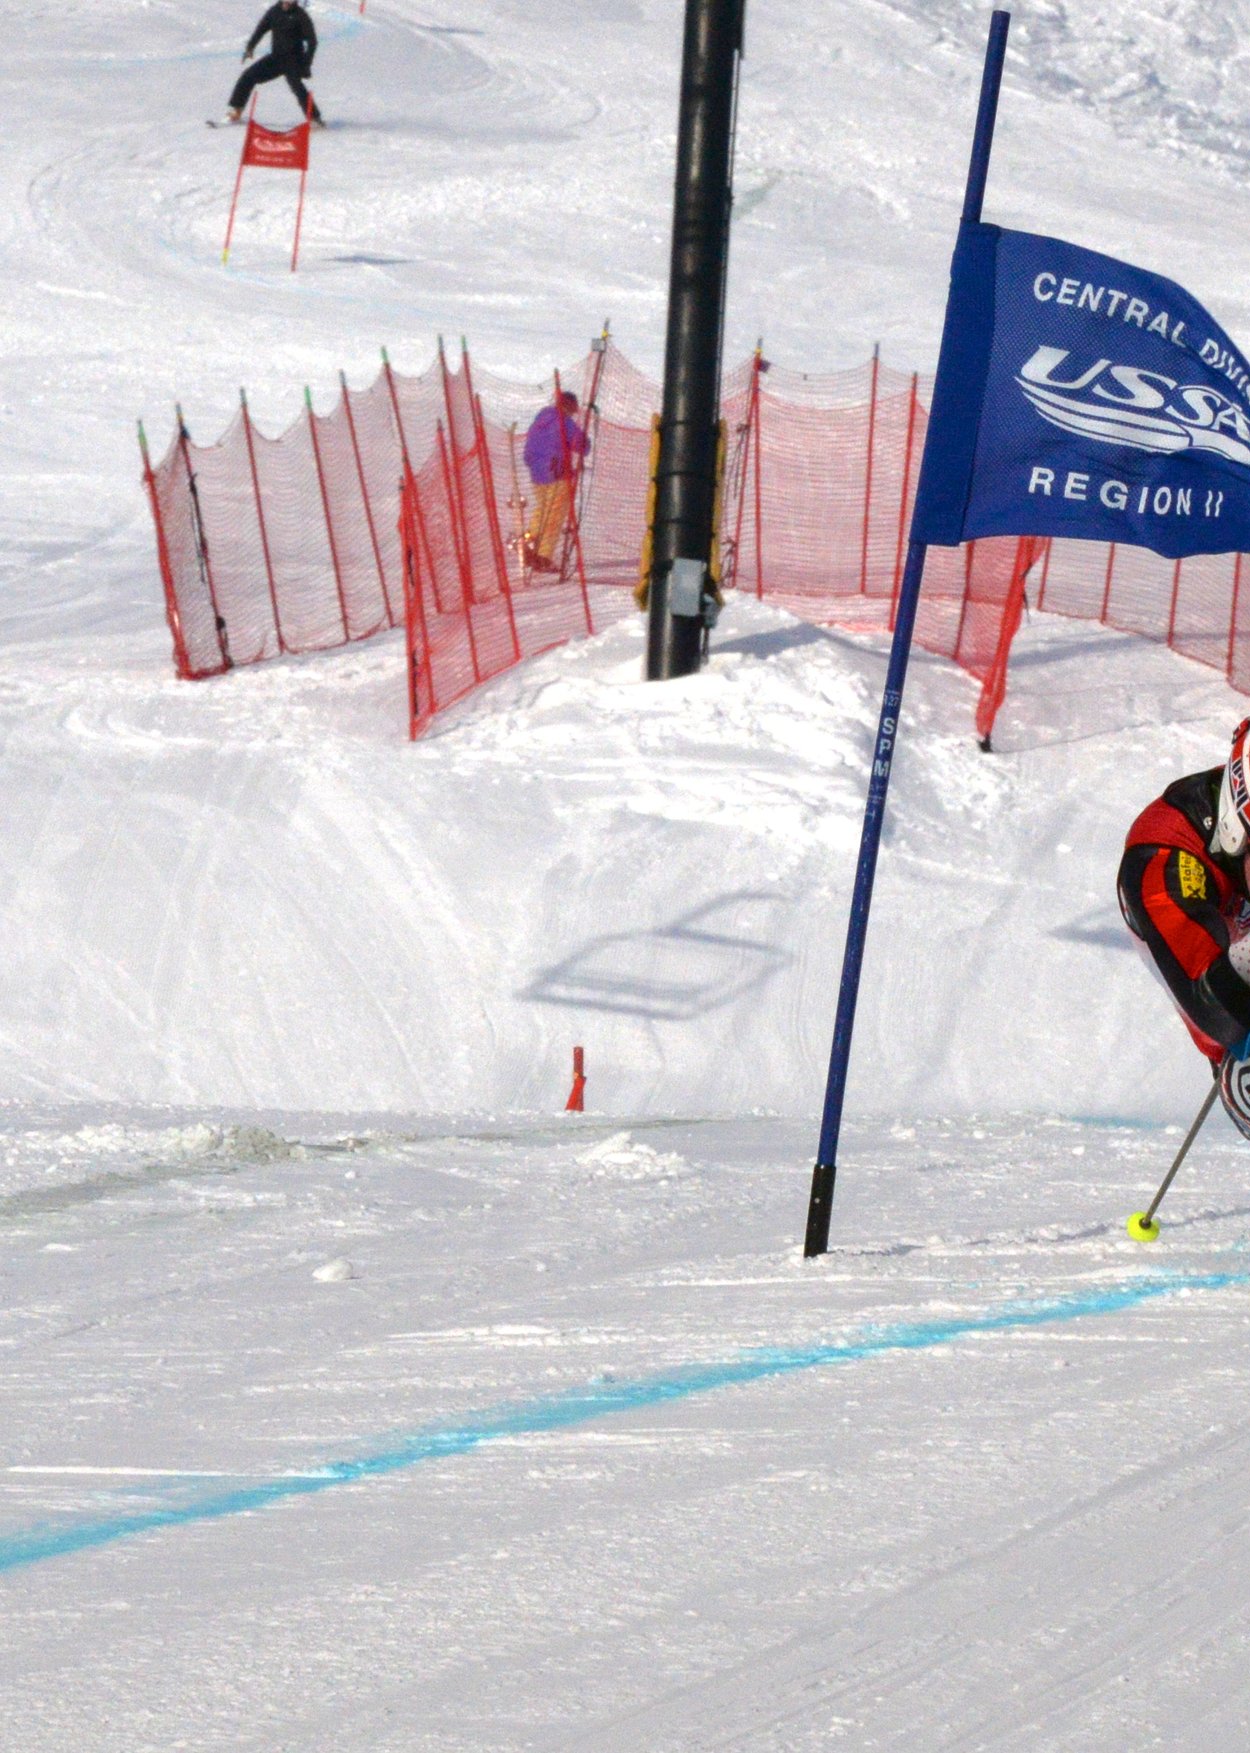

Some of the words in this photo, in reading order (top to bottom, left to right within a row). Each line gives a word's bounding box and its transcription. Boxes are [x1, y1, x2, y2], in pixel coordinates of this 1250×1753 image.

[1033, 272, 1187, 349] CENTRAL
[1028, 466, 1193, 517] REGION
[1205, 489, 1224, 517] II
